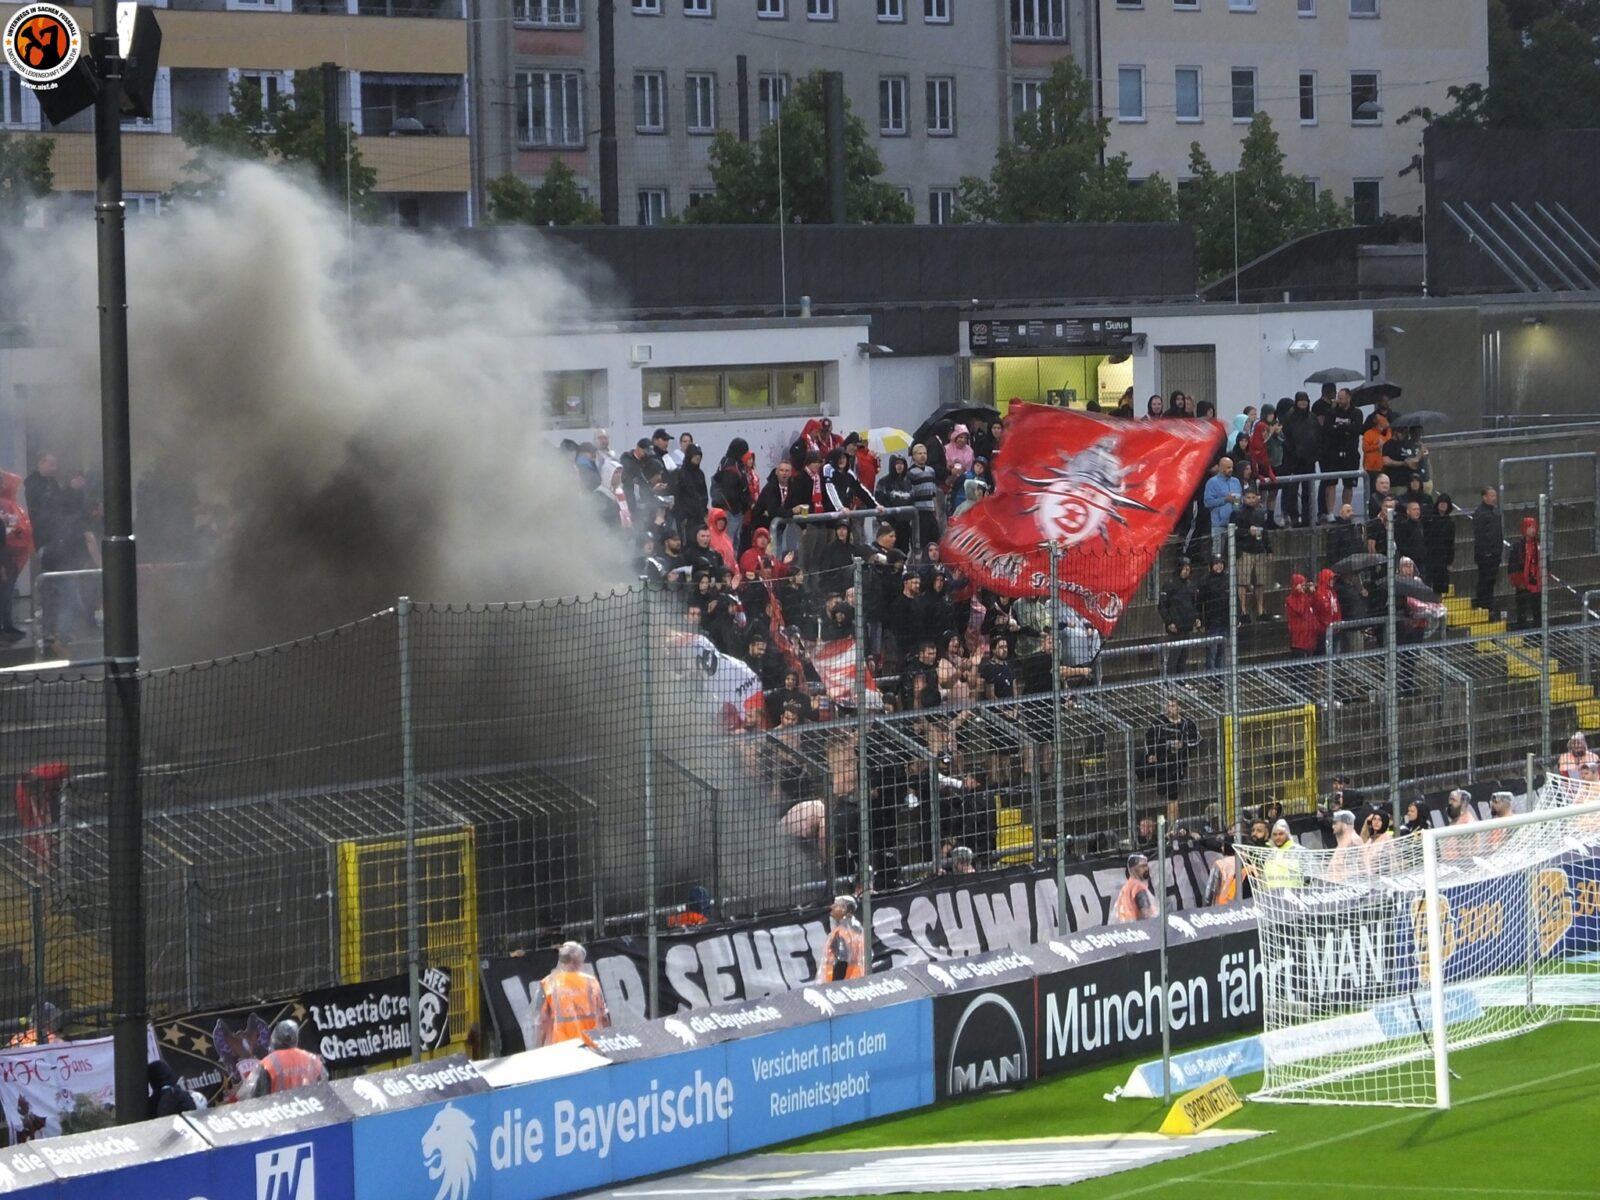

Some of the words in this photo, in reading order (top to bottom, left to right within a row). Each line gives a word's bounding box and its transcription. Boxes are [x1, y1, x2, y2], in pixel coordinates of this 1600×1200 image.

[1370, 354, 1381, 382] P
[1189, 913, 1208, 929] die
[1069, 940, 1094, 955] die
[1306, 922, 1383, 997] MAN
[423, 968, 448, 994] HFC
[826, 987, 848, 1004] die
[844, 977, 908, 1003] Bayerische
[949, 964, 974, 981] die
[309, 993, 380, 1031] Libertà
[379, 993, 410, 1021] Cre
[689, 1017, 717, 1035] die
[714, 1004, 783, 1031] Bayerische
[1046, 969, 1209, 1061] München
[1217, 944, 1296, 1019] fährt
[319, 1029, 382, 1061] Chemie
[379, 1021, 411, 1050] Hall
[751, 1046, 818, 1084] Versichert
[823, 1038, 855, 1070] nach
[858, 1029, 888, 1058] dem
[381, 1075, 413, 1098] die
[953, 1053, 1022, 1094] MAN
[1183, 1061, 1200, 1077] die
[769, 1072, 871, 1118] Reinheitsgebot
[1183, 1081, 1240, 1128] SPORTWETTEN
[207, 1112, 238, 1134] die
[230, 1096, 325, 1129] Bayerische
[490, 1107, 544, 1171] die
[554, 1068, 735, 1160] Bayerische
[12, 1152, 45, 1174] die
[43, 1134, 140, 1166] Bayerische
